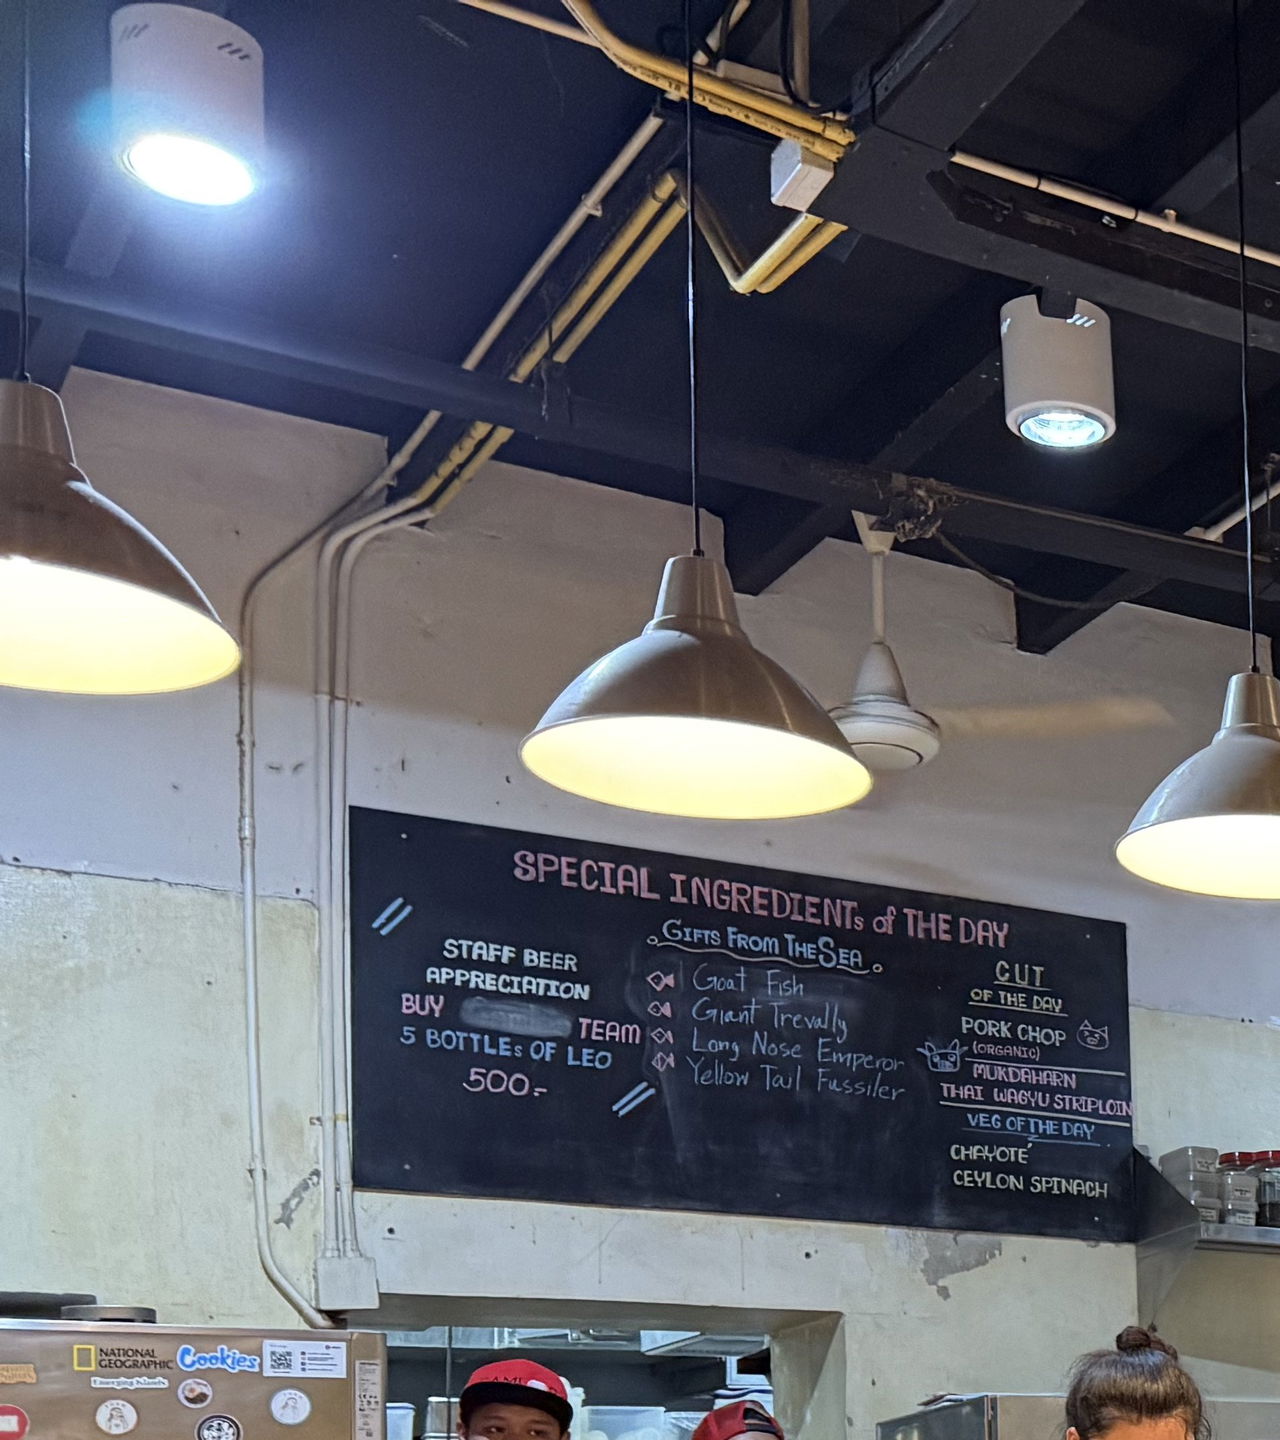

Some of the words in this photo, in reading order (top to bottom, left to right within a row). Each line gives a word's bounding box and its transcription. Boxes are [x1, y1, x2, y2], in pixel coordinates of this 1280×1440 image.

[513, 850, 661, 900] SPECIAL
[872, 903, 897, 935] of
[903, 907, 952, 941] THE
[959, 917, 1009, 948] DAY
[443, 938, 516, 964] STAFF
[523, 949, 578, 972] BEER
[426, 967, 591, 1000] APPRECIATION
[693, 963, 747, 992] Goat
[766, 969, 804, 998] Fish
[995, 960, 1045, 986] CUT
[970, 988, 993, 1003] OF
[998, 991, 1027, 1008] THE
[1032, 996, 1063, 1013] DAY
[401, 993, 444, 1018] BUY
[578, 1017, 641, 1044] TEAM
[691, 997, 762, 1025] Giant
[768, 1002, 848, 1044] Trevally
[961, 1016, 1012, 1039] PORK
[1017, 1024, 1066, 1047] CHOP
[400, 1027, 416, 1045] 5
[530, 1040, 557, 1061] OF
[567, 1046, 612, 1069] LEO
[692, 1027, 740, 1061] Long
[753, 1031, 802, 1058] Nose
[817, 1037, 904, 1072] Emperor
[972, 1041, 1040, 1061] (ORGANIC)
[686, 1055, 749, 1086] Yellow
[760, 1065, 801, 1091] Tail
[973, 1064, 1077, 1089] MUKDAHARN
[940, 1082, 984, 1101] THAI
[993, 1088, 1050, 1108] WAGYU
[1053, 1094, 1133, 1117] STRIPLOIN
[967, 1113, 1001, 1129] VEG
[1005, 1115, 1027, 1132] OF
[1027, 1118, 1059, 1136] THE
[1061, 1122, 1095, 1141] DAY
[953, 1169, 1024, 1191] CEYLON
[1030, 1176, 1108, 1199] SPINACH
[98, 1358, 174, 1370] GEOGRAPHIC
[99, 1347, 158, 1359] NATIONAL
[179, 1347, 257, 1371] Cookies
